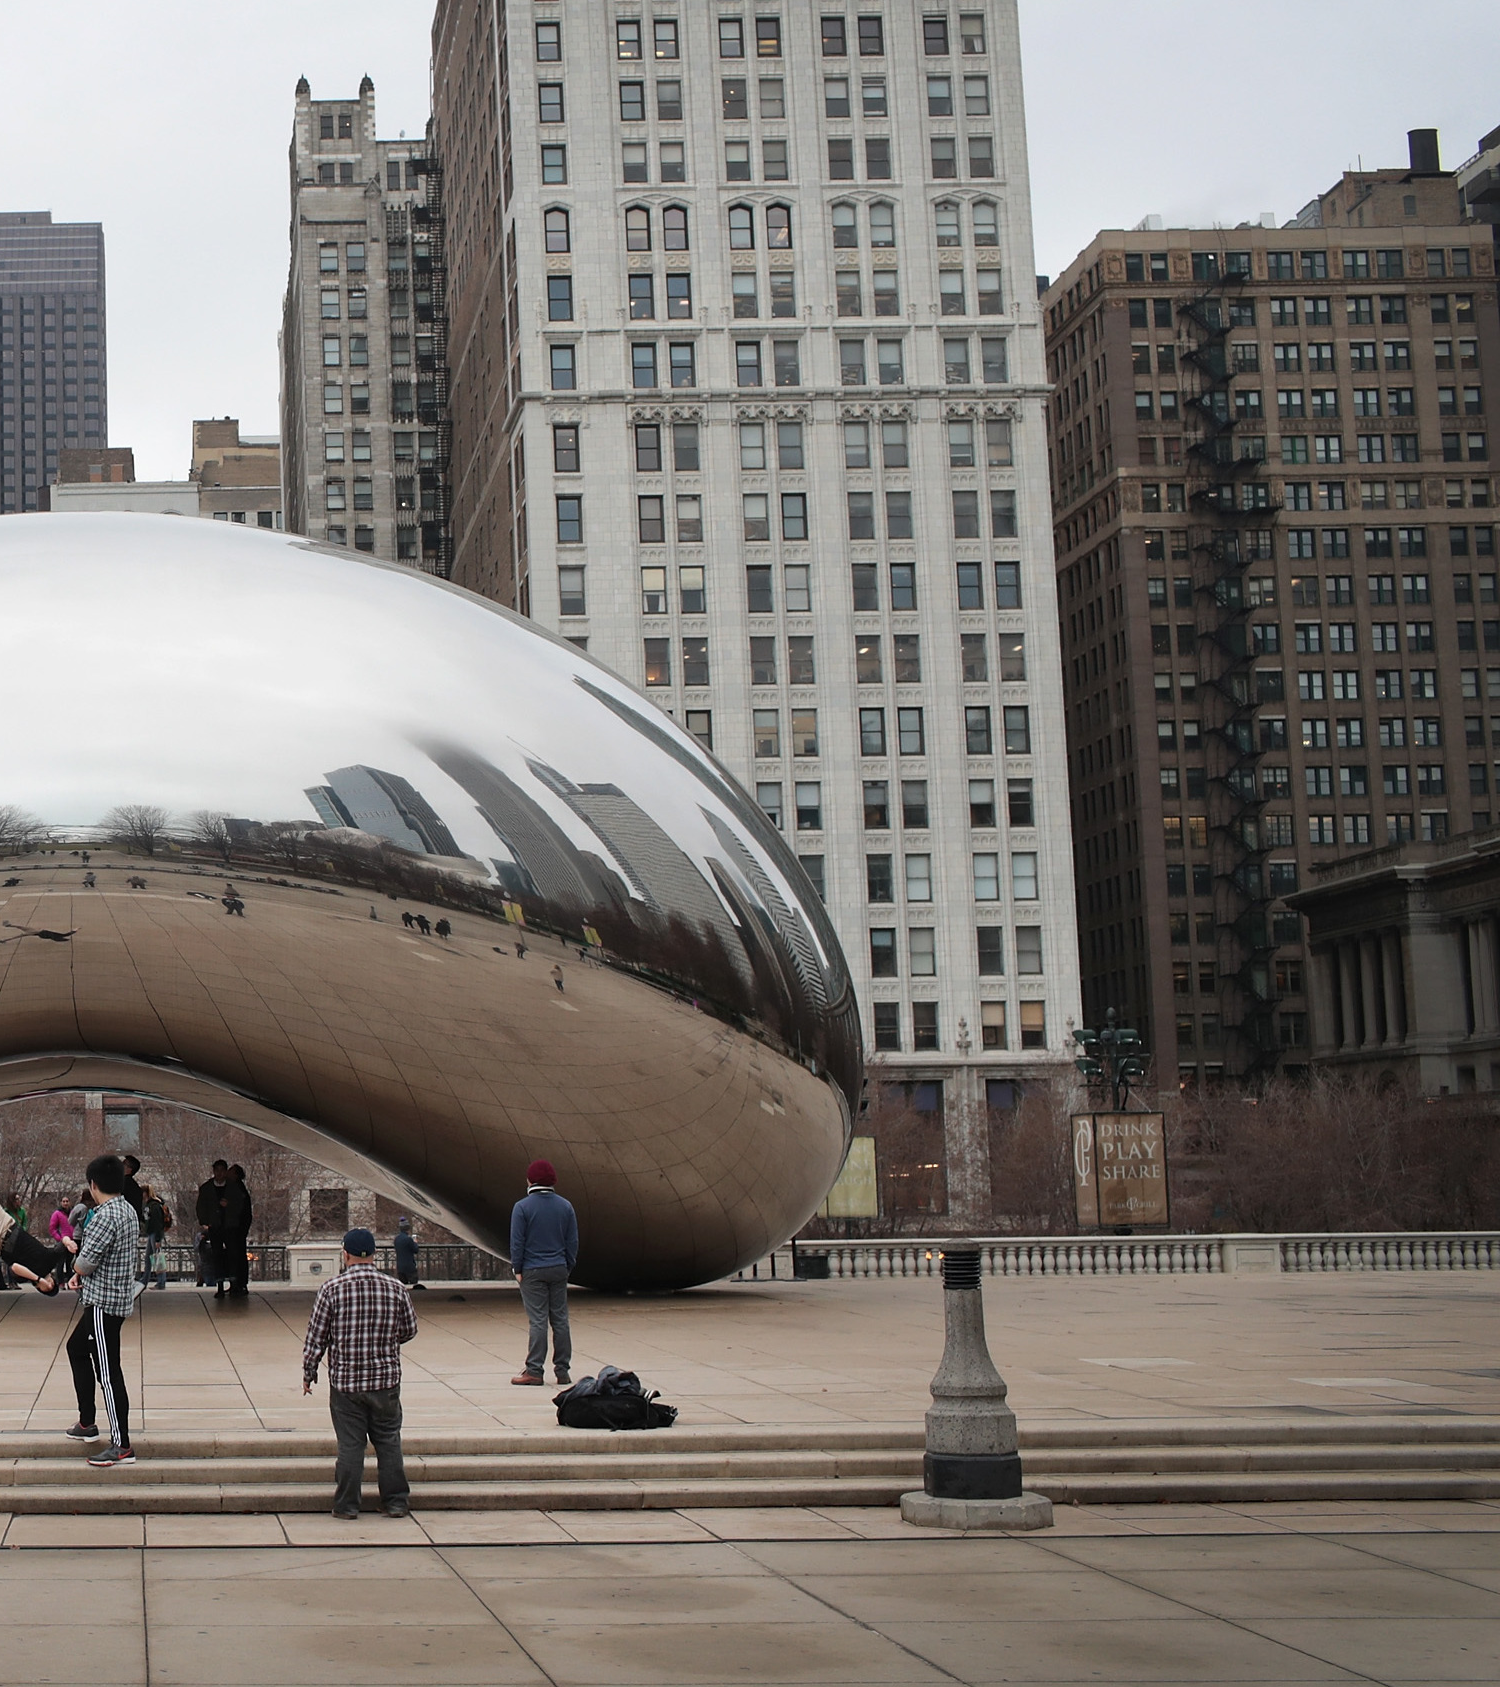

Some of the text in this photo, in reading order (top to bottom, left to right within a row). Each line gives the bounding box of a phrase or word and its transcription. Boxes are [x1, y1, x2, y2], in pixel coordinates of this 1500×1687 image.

[1101, 1123, 1157, 1137] DRINK
[1102, 1141, 1157, 1160] PLAY
[1103, 1164, 1161, 1180] SHARE
[836, 1175, 873, 1186] AUGH
